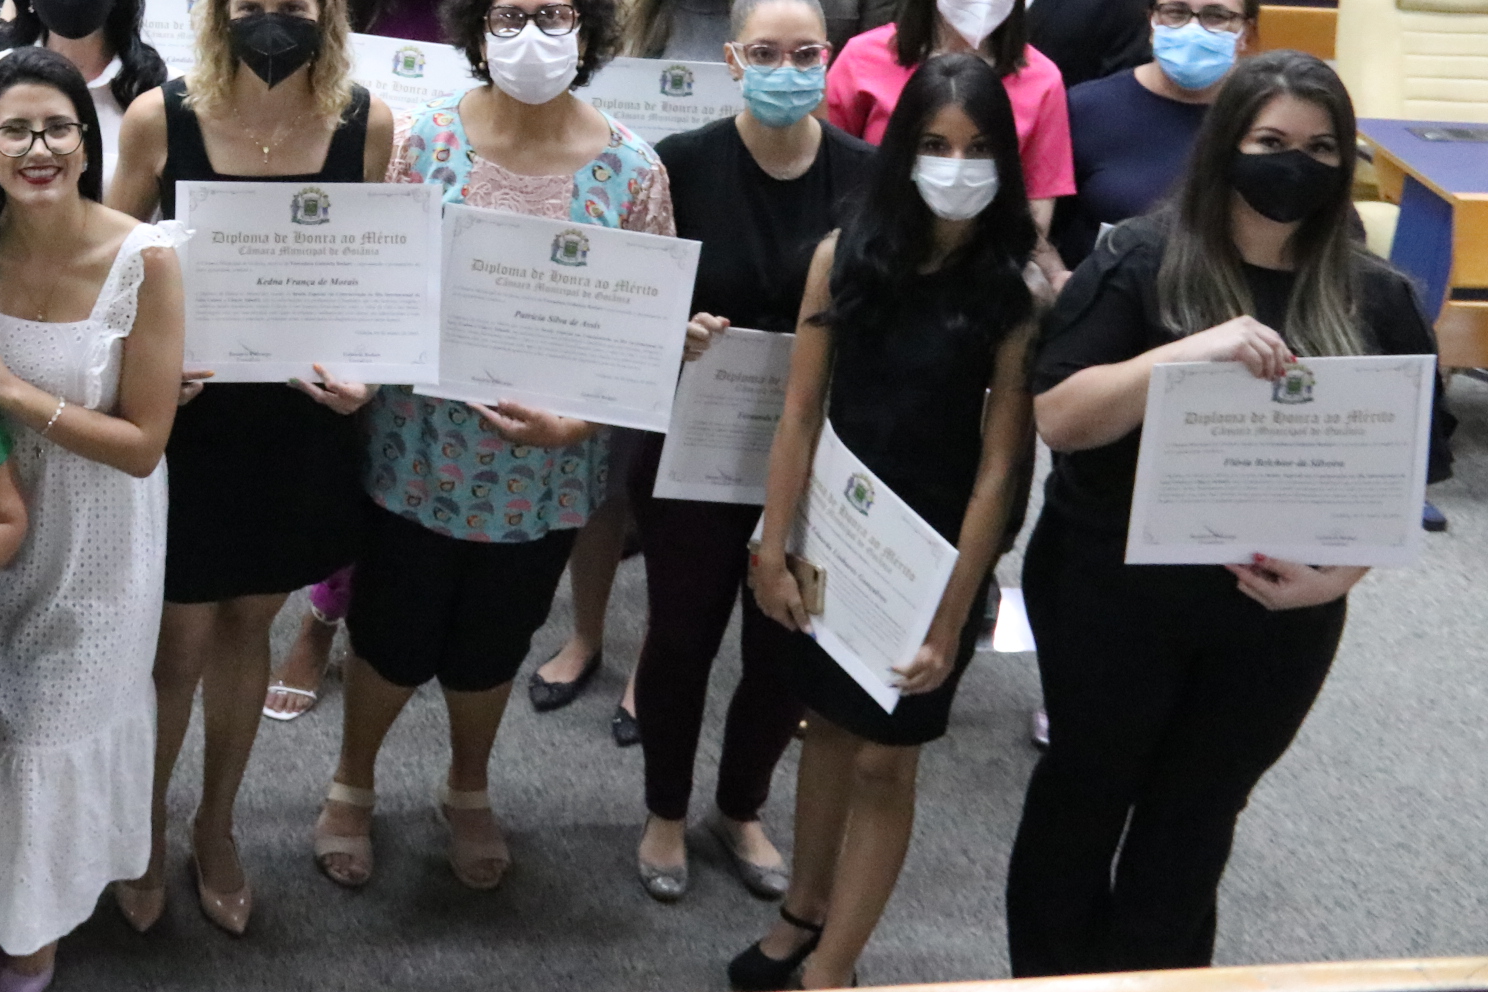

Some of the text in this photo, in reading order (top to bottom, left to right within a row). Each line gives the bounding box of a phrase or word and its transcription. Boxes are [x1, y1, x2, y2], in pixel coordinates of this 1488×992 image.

[375, 80, 387, 89] de
[391, 81, 427, 95] Honra
[591, 97, 640, 111] Diploma
[644, 100, 656, 111] de
[661, 101, 697, 113] Honra
[701, 105, 714, 114] ao
[212, 230, 407, 246] Diploma de Honra ao Mérito
[238, 245, 379, 257] Câmara Municipal de Goiânia
[286, 277, 315, 287] França
[319, 277, 328, 286] de
[471, 258, 658, 297] Diploma de Honra ao Mérito
[495, 277, 530, 291] Câmara
[582, 290, 591, 299] de
[1184, 412, 1246, 425] Diploma
[1250, 412, 1266, 423] de
[1324, 413, 1341, 423] ao
